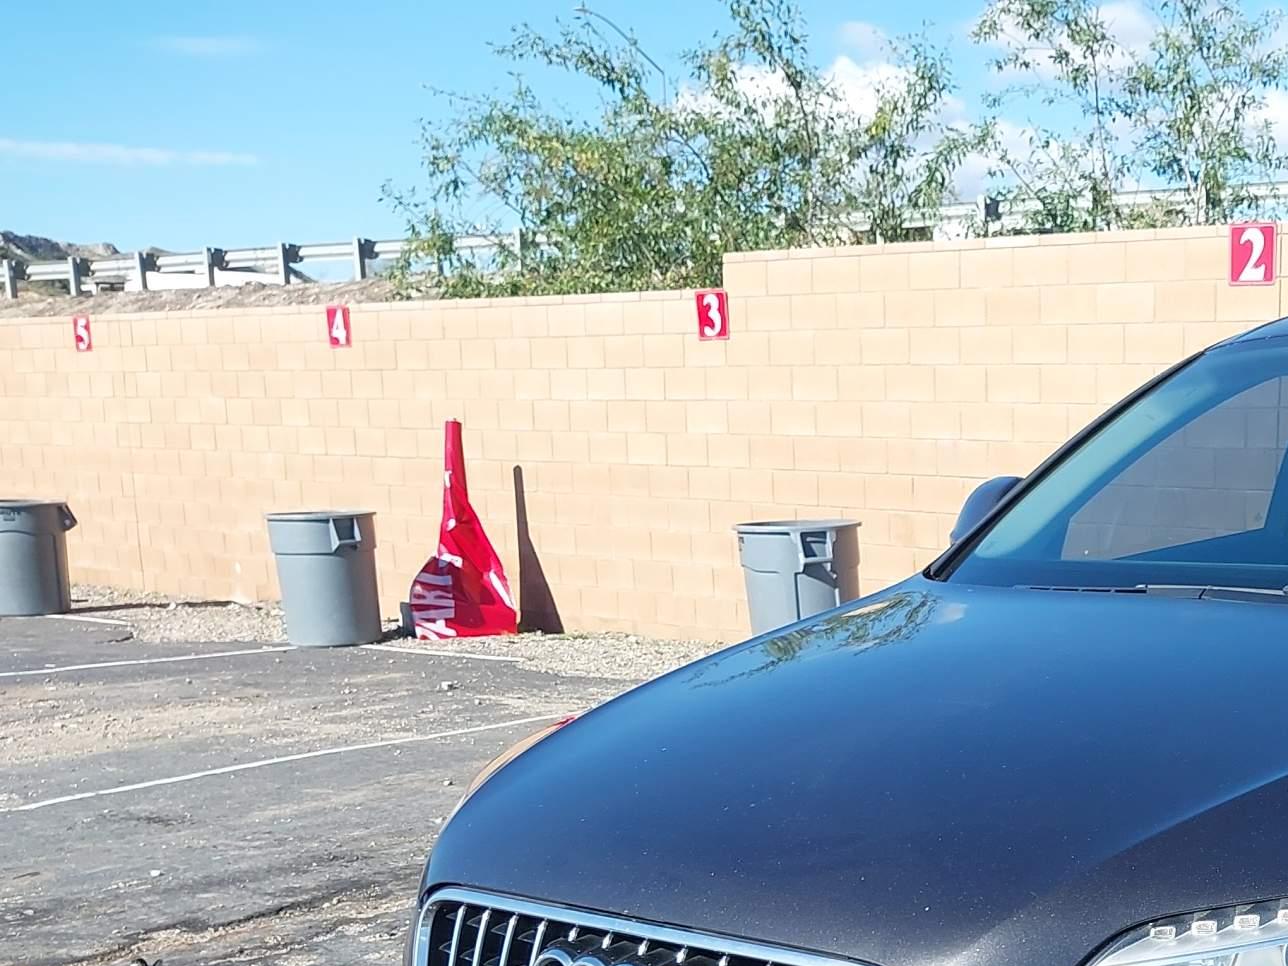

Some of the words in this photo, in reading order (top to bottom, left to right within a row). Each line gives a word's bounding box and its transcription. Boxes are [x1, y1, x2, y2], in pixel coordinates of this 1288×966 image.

[1237, 226, 1266, 281] 2
[76, 317, 88, 350] 5
[332, 307, 346, 344] 4
[703, 293, 722, 337] 3
